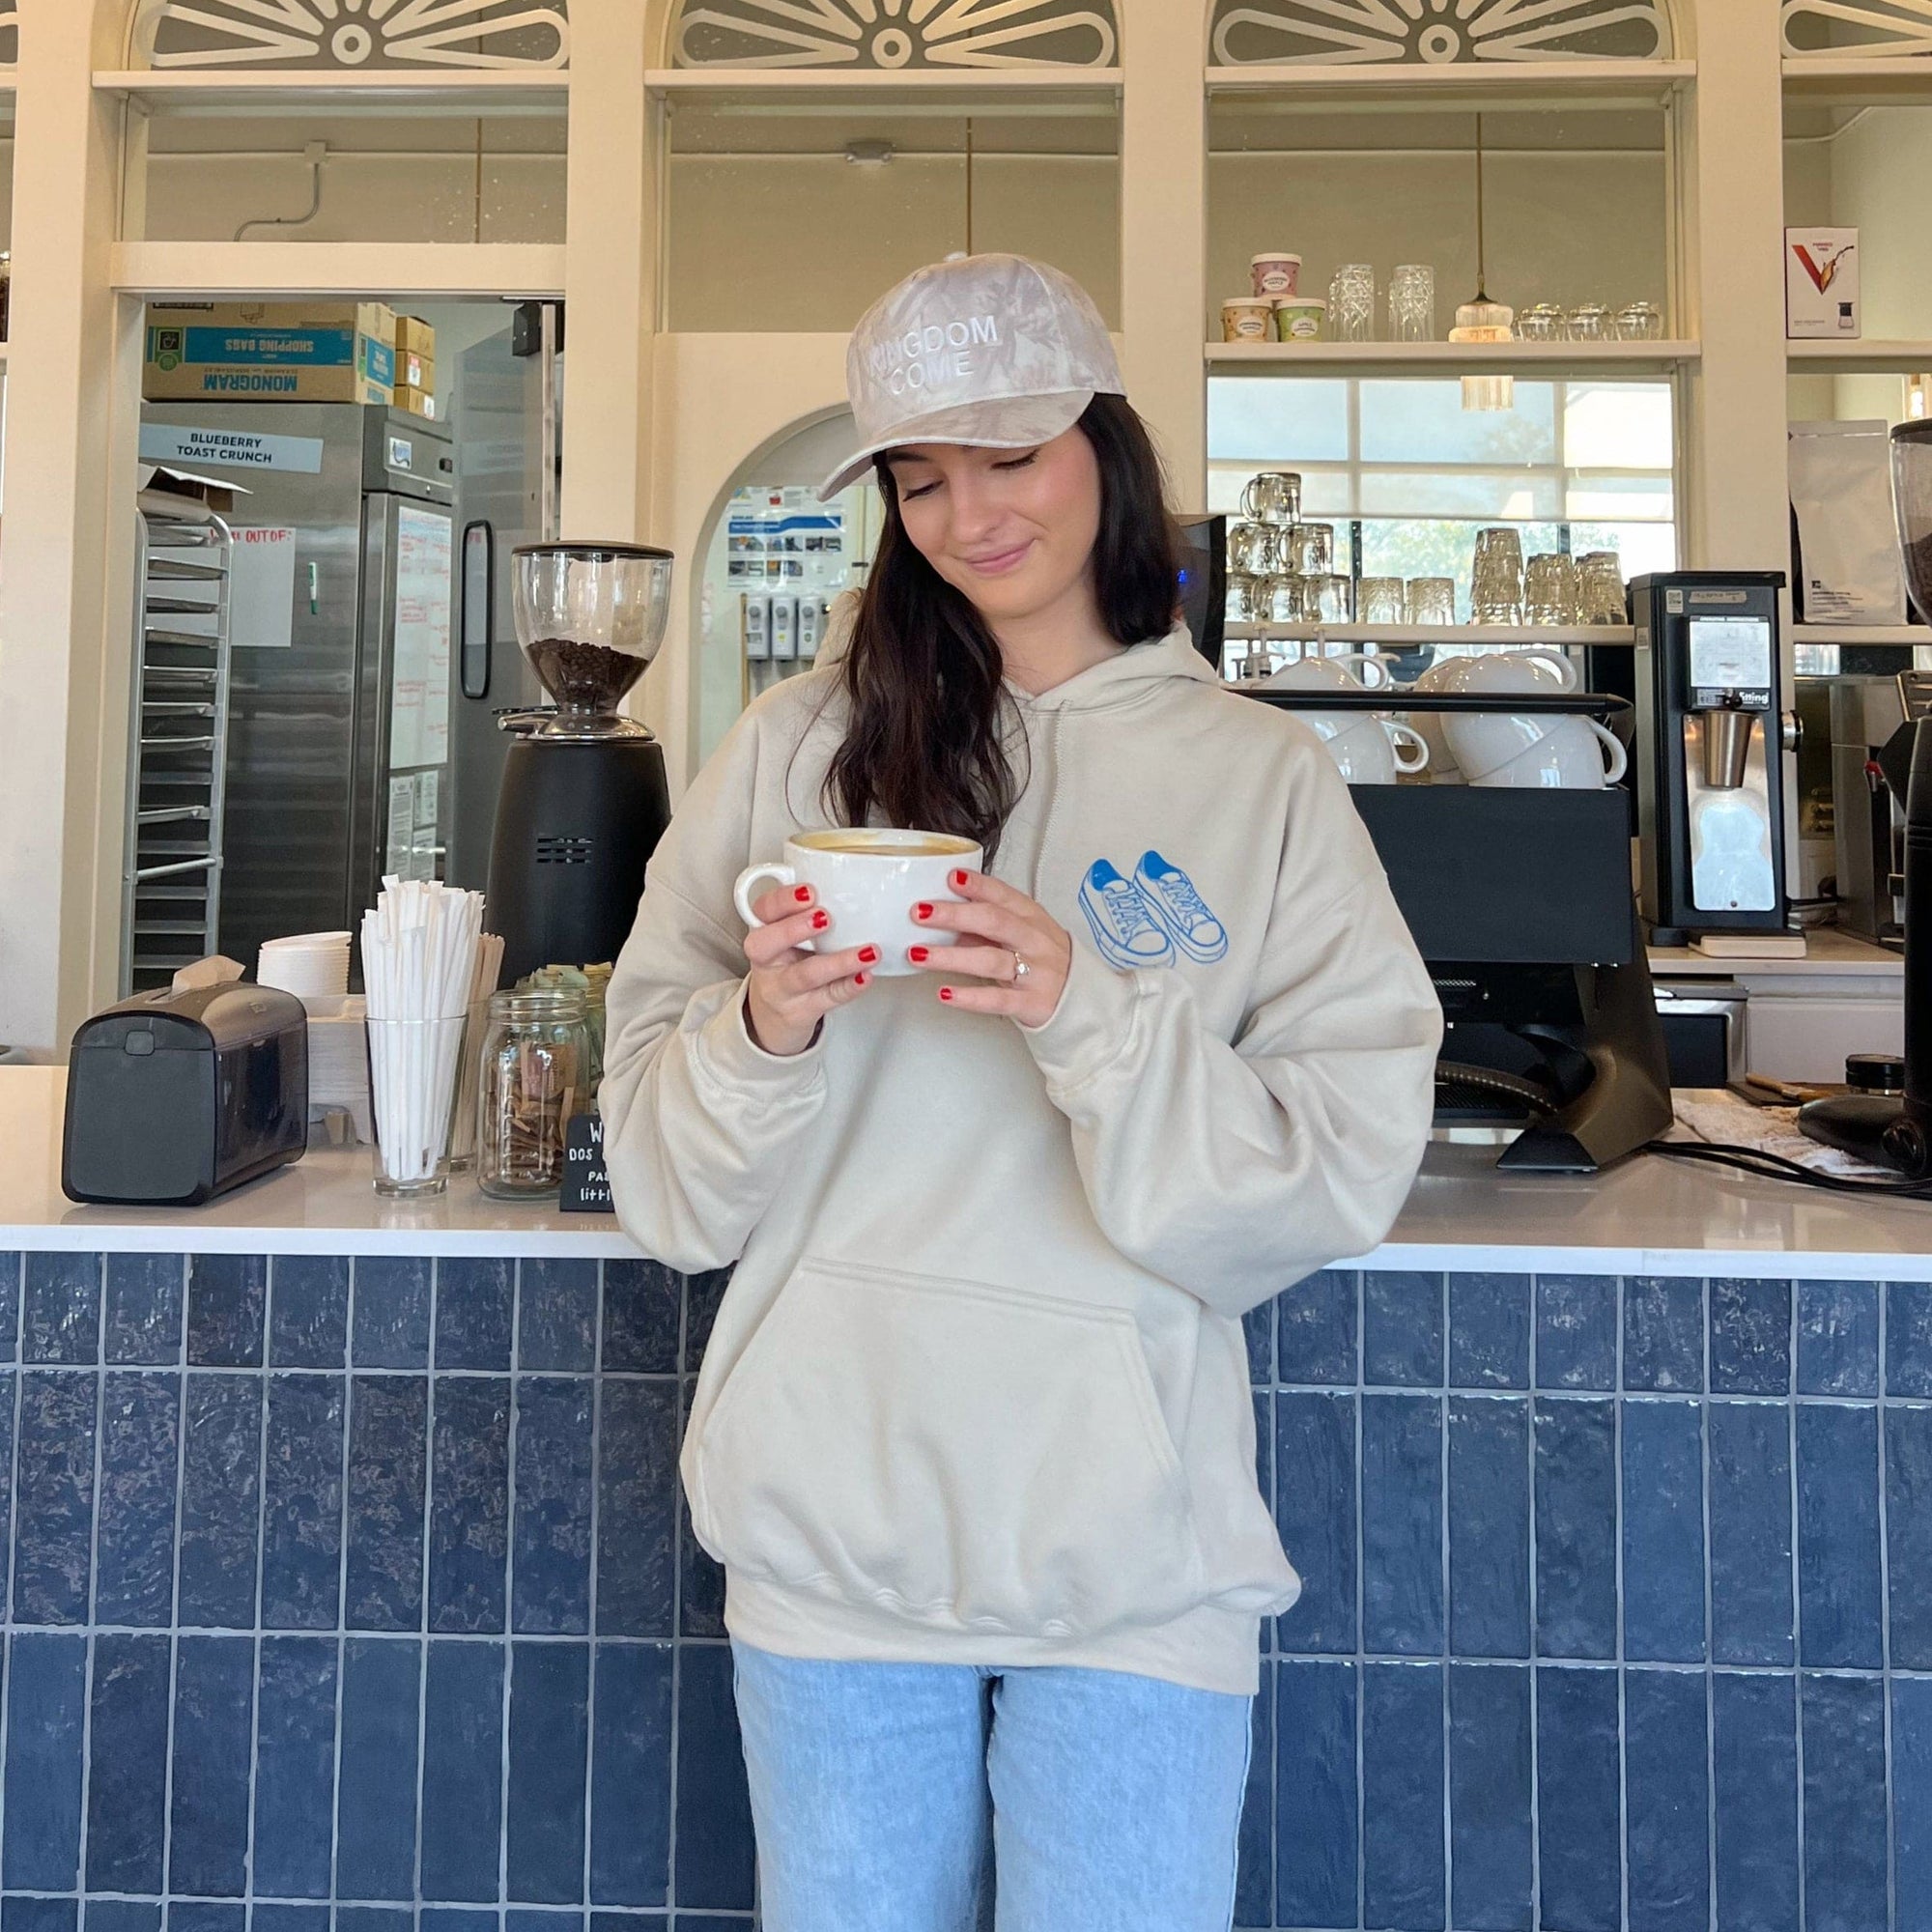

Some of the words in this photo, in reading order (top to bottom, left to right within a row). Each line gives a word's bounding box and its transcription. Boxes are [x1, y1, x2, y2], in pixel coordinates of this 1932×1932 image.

[225, 338, 256, 352] BAGS
[259, 339, 314, 353] SHOPPING
[890, 349, 974, 394] COME
[204, 374, 298, 391] MONOGRAM
[190, 433, 262, 448] BLUEBERRY
[177, 445, 215, 458] TOAST
[219, 449, 272, 463] CRUNCH
[245, 529, 270, 543] OUT
[569, 1148, 593, 1161] DOS
